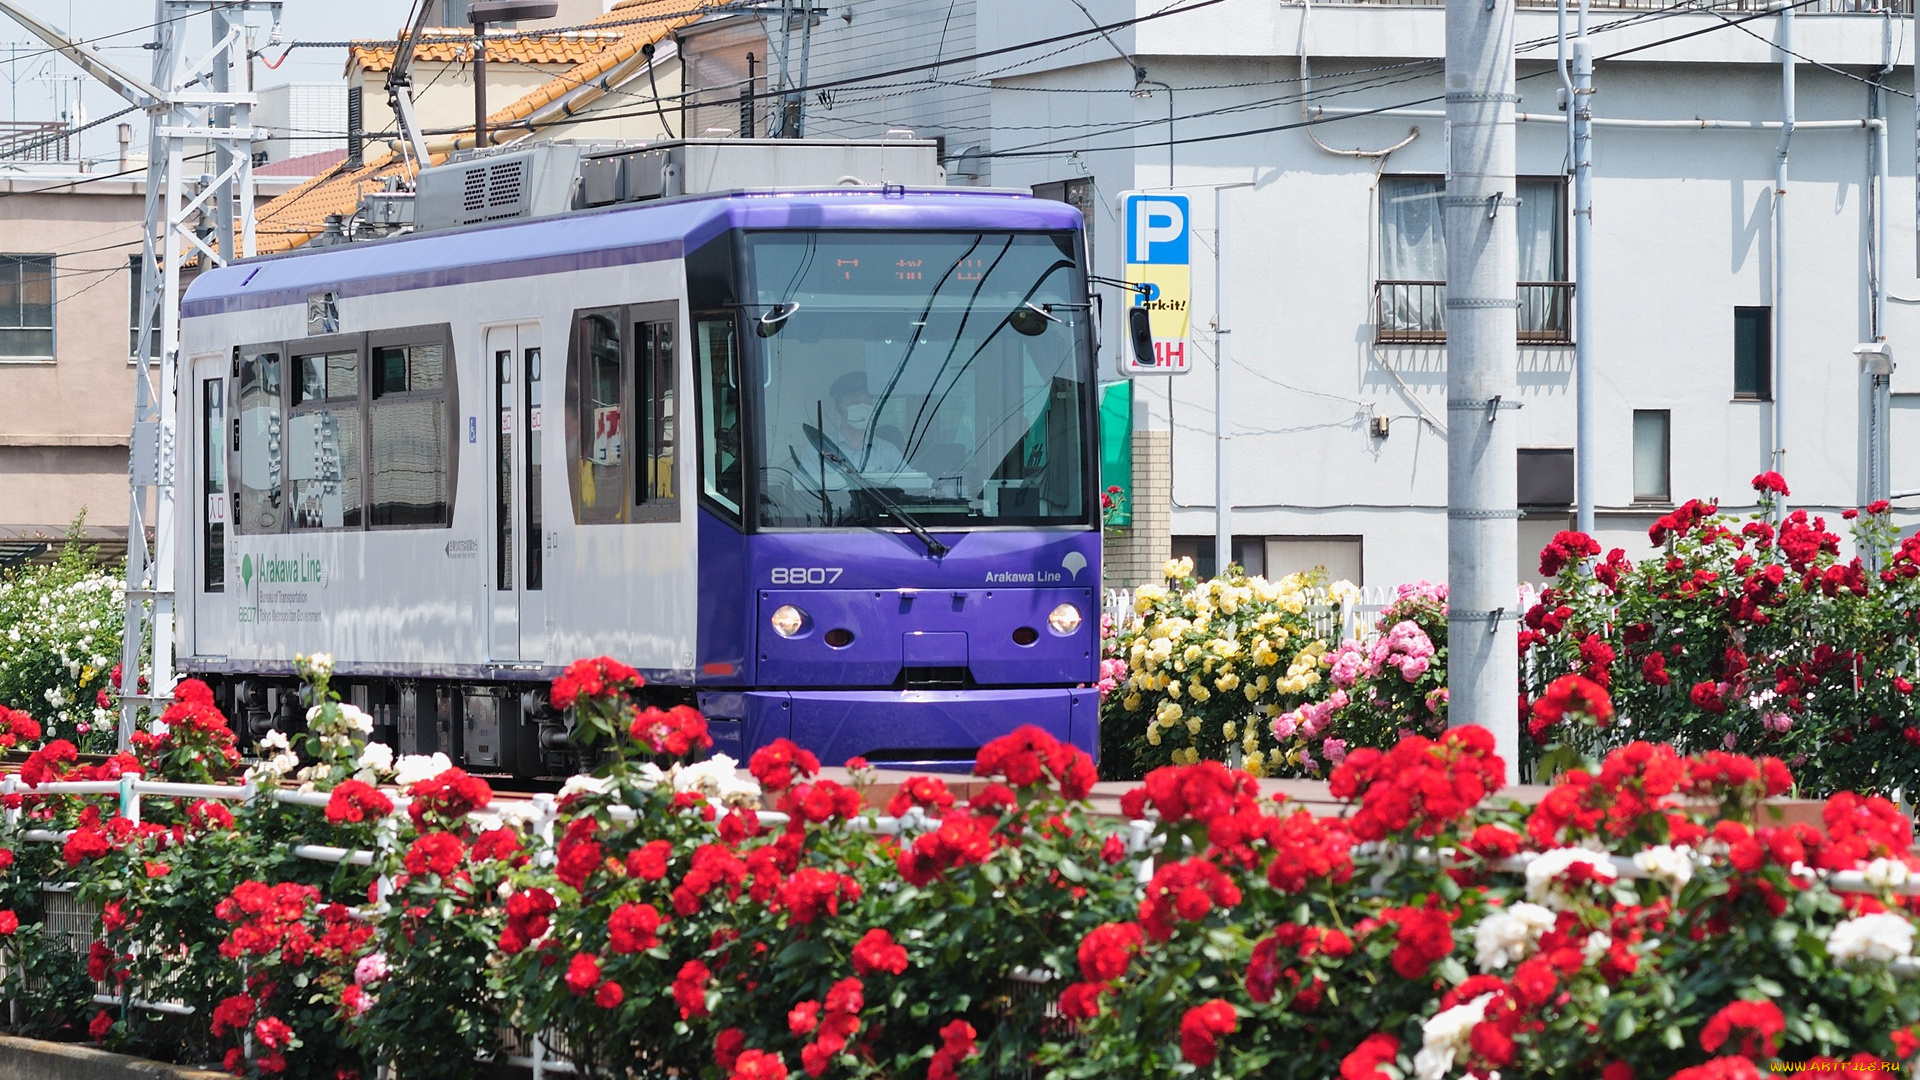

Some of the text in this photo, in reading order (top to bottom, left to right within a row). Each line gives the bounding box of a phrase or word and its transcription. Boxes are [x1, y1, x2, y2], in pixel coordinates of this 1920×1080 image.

[1136, 201, 1184, 262] P
[1132, 342, 1184, 367] 4H
[210, 496, 224, 519] 入口
[260, 553, 299, 583] Arakawa
[301, 552, 321, 583] Line
[771, 567, 844, 584] 8807
[985, 570, 1061, 583] Arakawa Line
[239, 606, 257, 622] 8807
